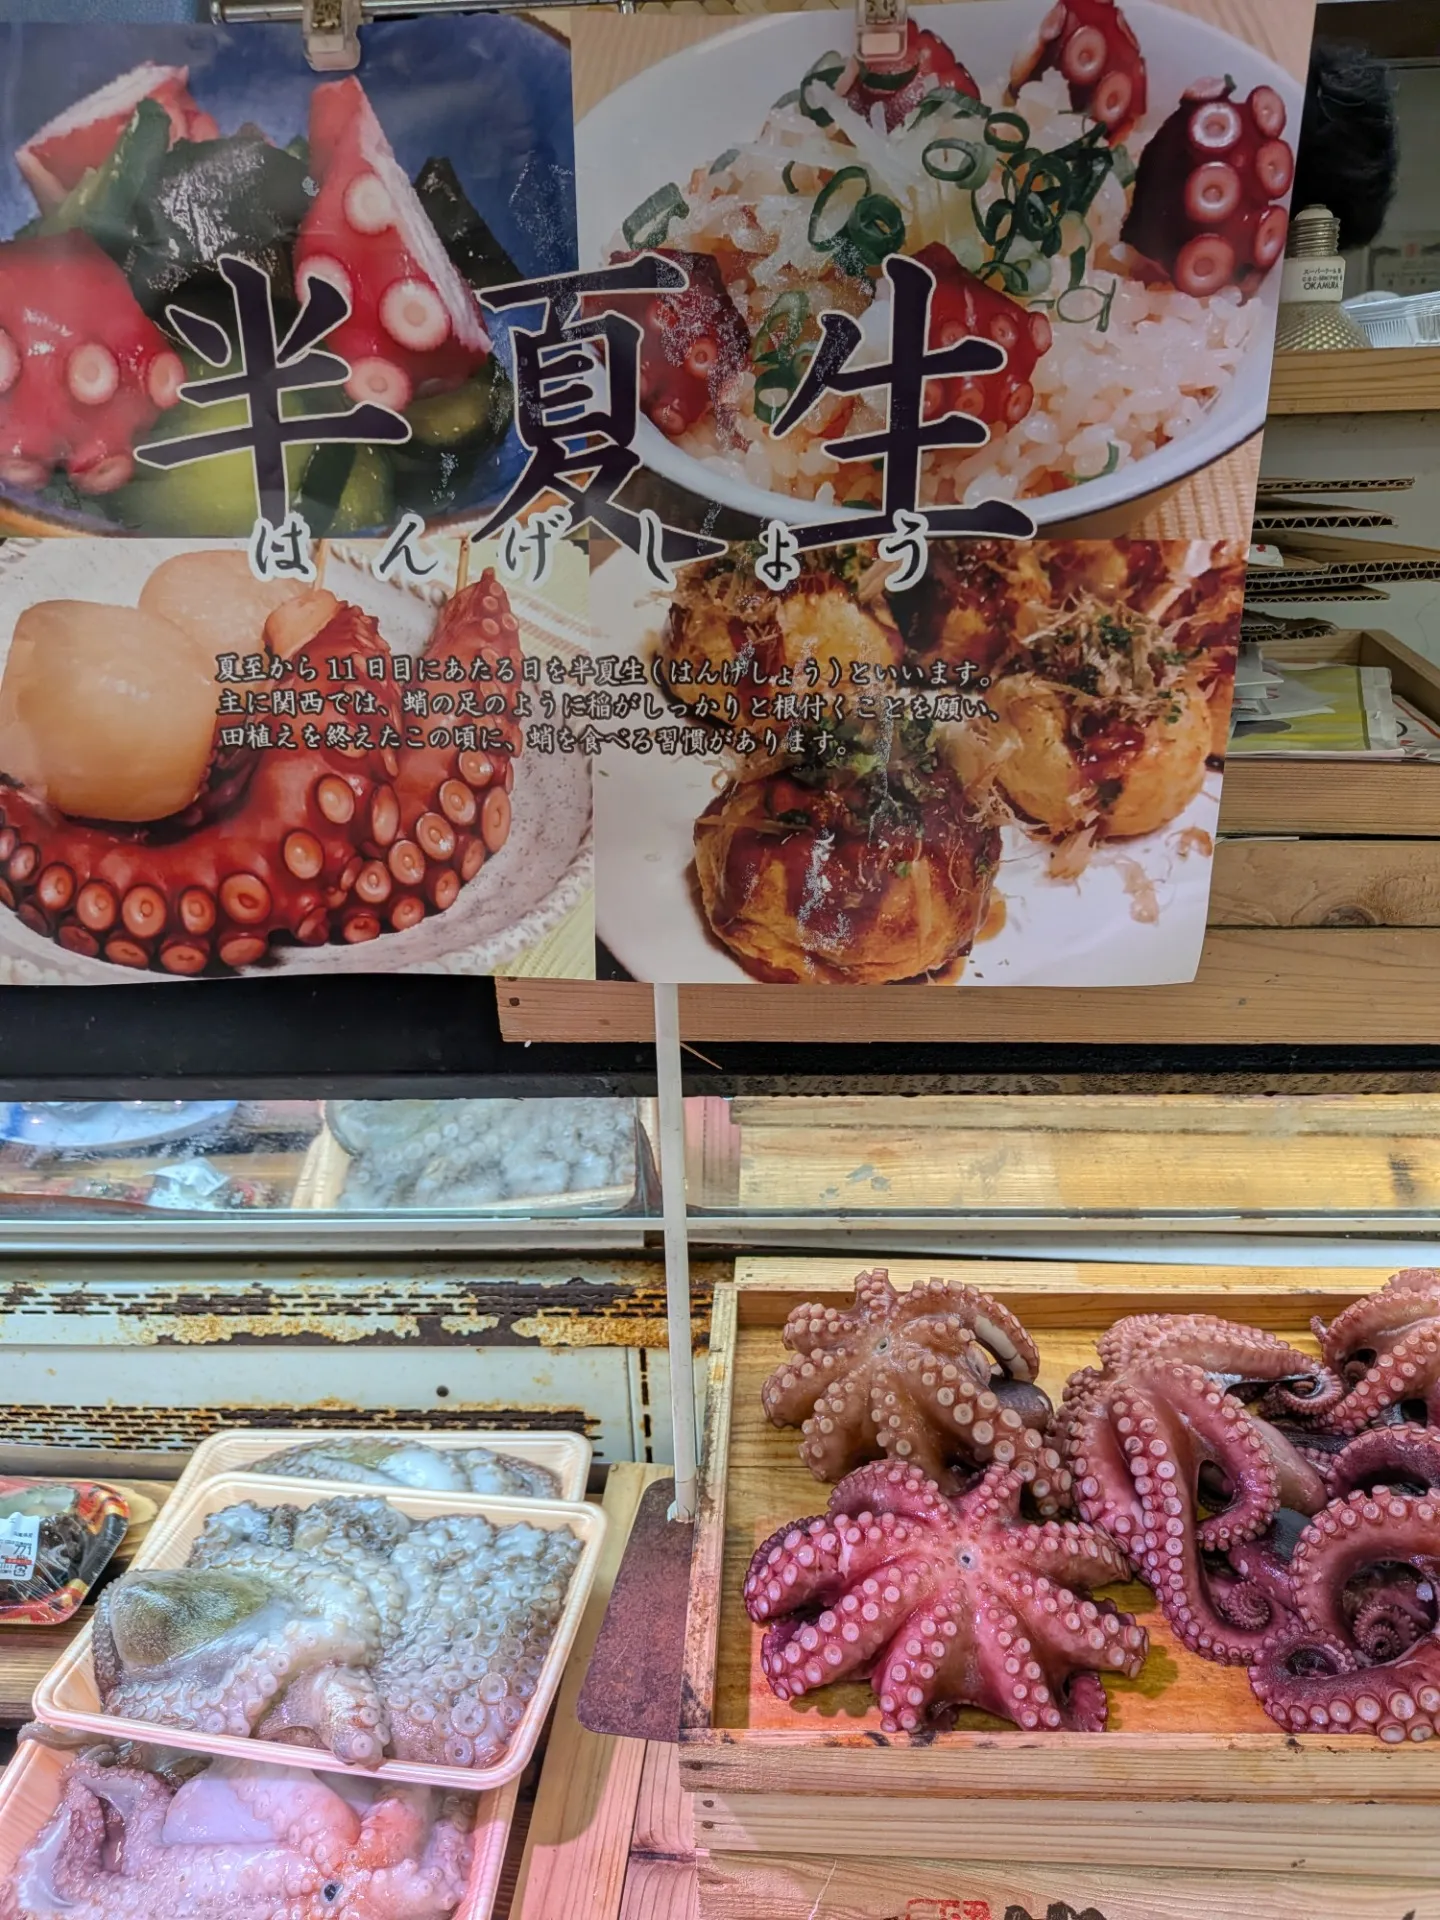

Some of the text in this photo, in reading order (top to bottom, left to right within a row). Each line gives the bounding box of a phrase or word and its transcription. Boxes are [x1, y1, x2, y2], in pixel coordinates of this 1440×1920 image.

[136, 252, 1038, 562] 半夏生
[249, 508, 928, 589] はんげしょう
